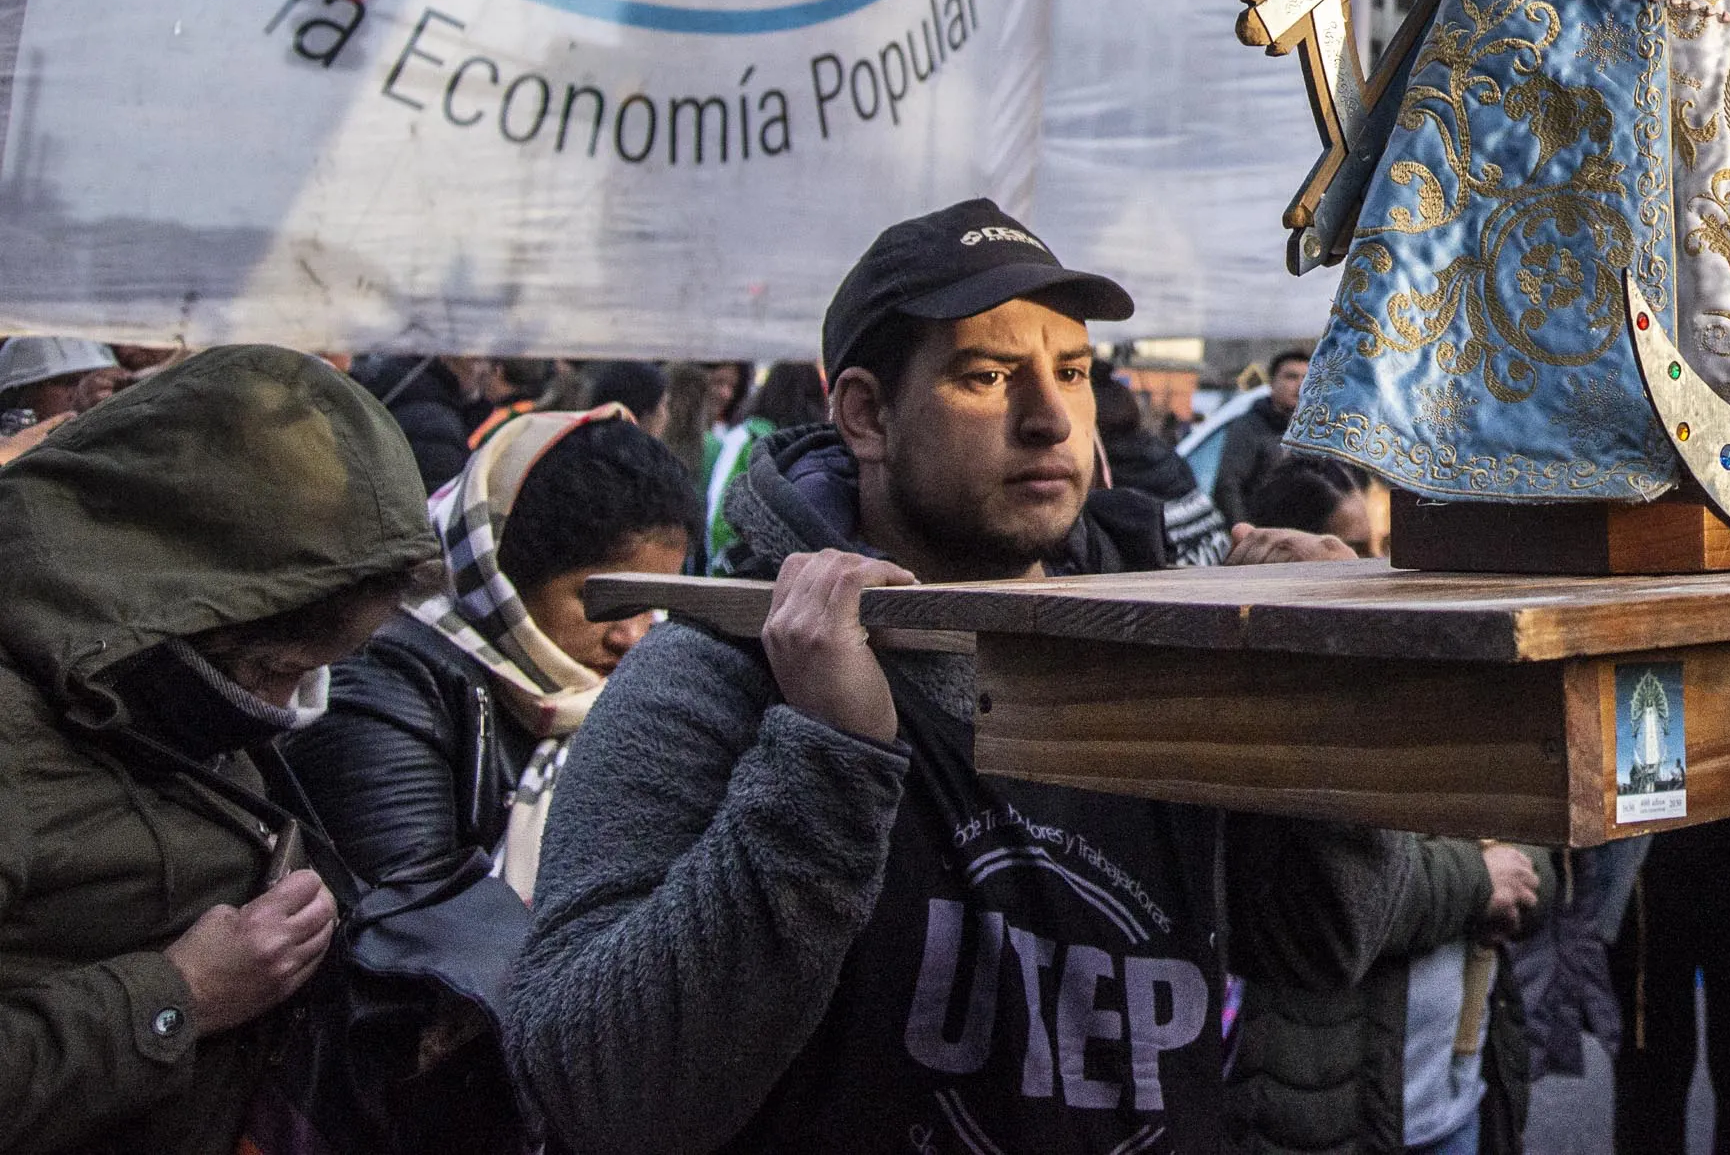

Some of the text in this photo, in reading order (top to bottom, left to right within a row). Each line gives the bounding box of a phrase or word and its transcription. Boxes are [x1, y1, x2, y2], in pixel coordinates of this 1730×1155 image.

[381, 6, 794, 165] Economía
[1075, 833, 1172, 935] Trabajadoras
[904, 897, 1209, 1112] UTEP
